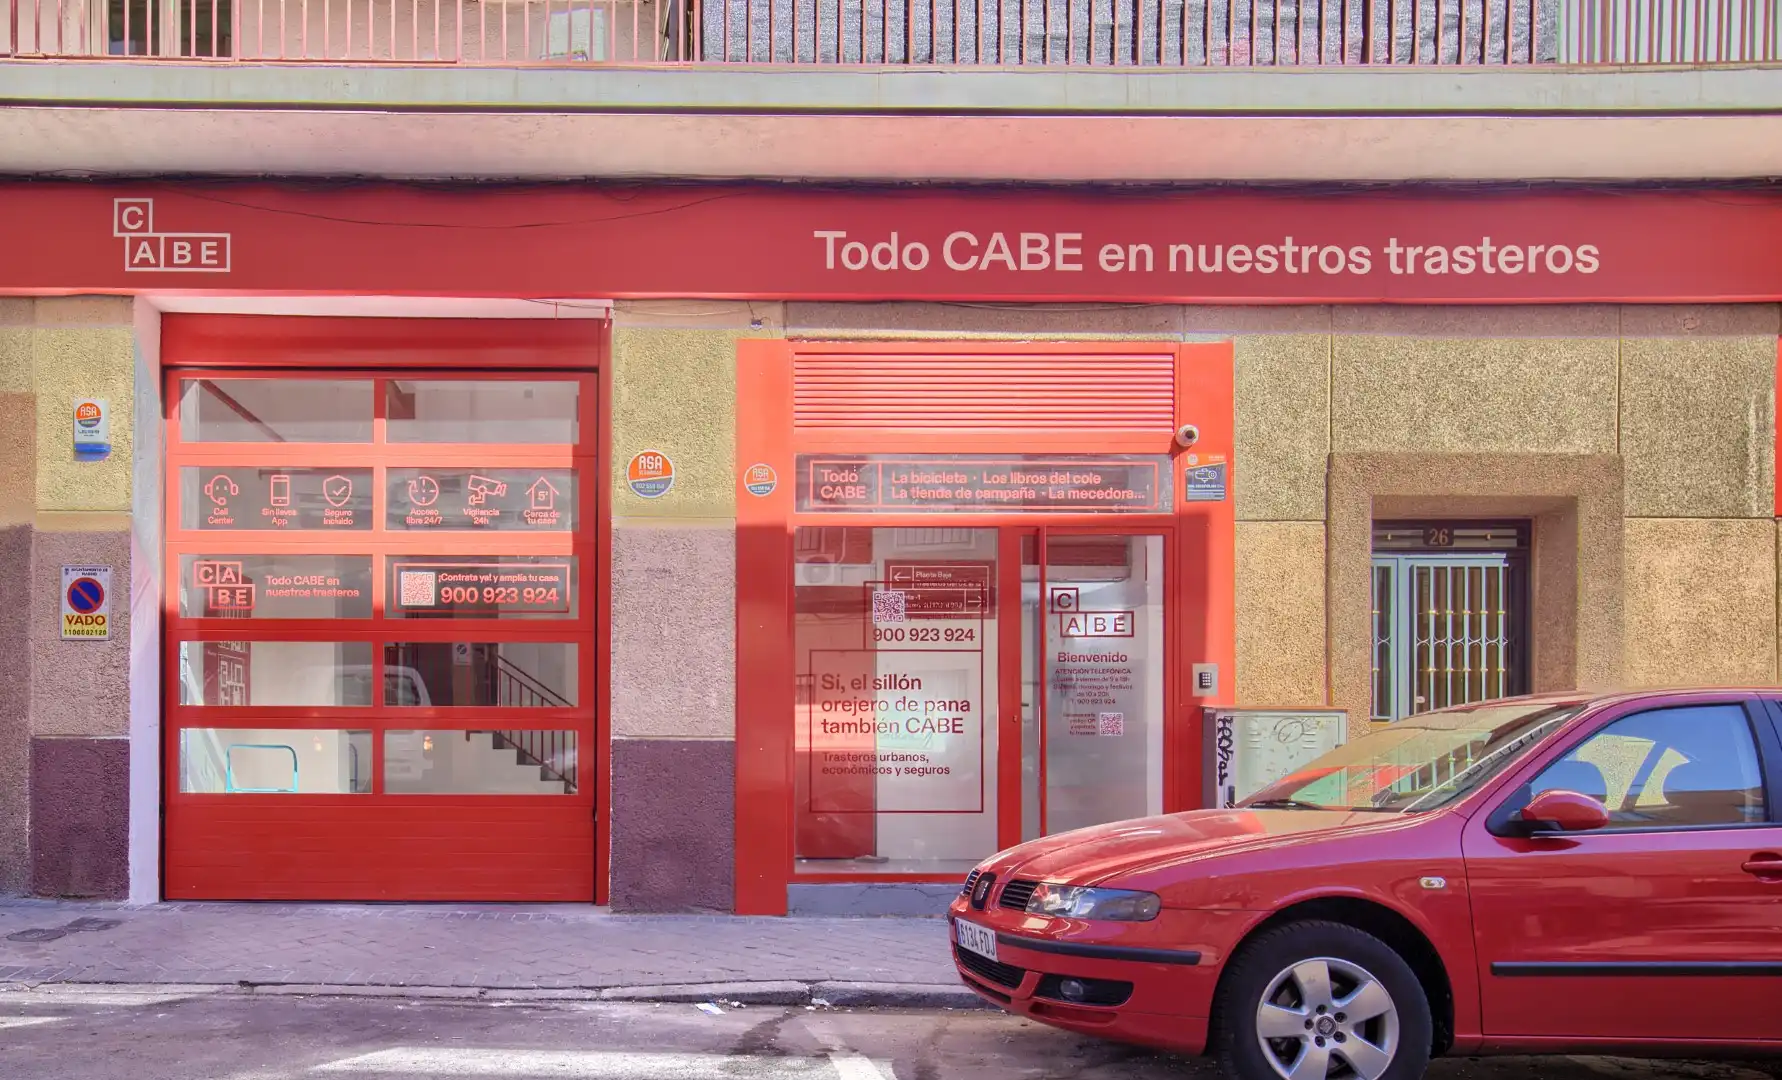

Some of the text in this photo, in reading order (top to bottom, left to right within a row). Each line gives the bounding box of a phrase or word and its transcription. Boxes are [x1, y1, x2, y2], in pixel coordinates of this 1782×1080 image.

[814, 230, 1600, 274] Todo CABE en nuestros trasteros
[80, 406, 97, 417] ASA
[639, 455, 663, 470] ASA
[753, 468, 769, 479] ASA
[820, 469, 859, 483] Todo
[892, 471, 1101, 484] La bicicleta Los libros del cole
[820, 485, 867, 499] CABE
[892, 486, 1145, 502] La tienda de campaña La mecedora...
[213, 507, 229, 515] Call
[324, 508, 352, 518] Seguro
[410, 508, 439, 516] Acceso
[463, 508, 500, 518] Vigilancia
[524, 510, 549, 518] Cerca
[208, 516, 235, 525] Center
[271, 517, 288, 526] App
[424, 516, 443, 525] 24/7
[473, 516, 489, 525] 24h
[1429, 527, 1448, 545] 26
[265, 575, 340, 585] Todo CABE en
[491, 575, 498, 583] y
[265, 588, 359, 597] nuestros trasteros
[440, 587, 559, 604] 900 923 924
[65, 615, 106, 626] VADO
[873, 628, 975, 642] 900 923 924
[1057, 651, 1128, 663] Bienvenido
[851, 673, 867, 691] el
[872, 673, 922, 691] sillón
[821, 696, 971, 717] orejero de pana
[821, 717, 964, 734] también CABE
[822, 752, 929, 764] Trasteros urbanos,
[821, 764, 950, 777] económicos y seguros
[979, 929, 995, 957] FDJ
